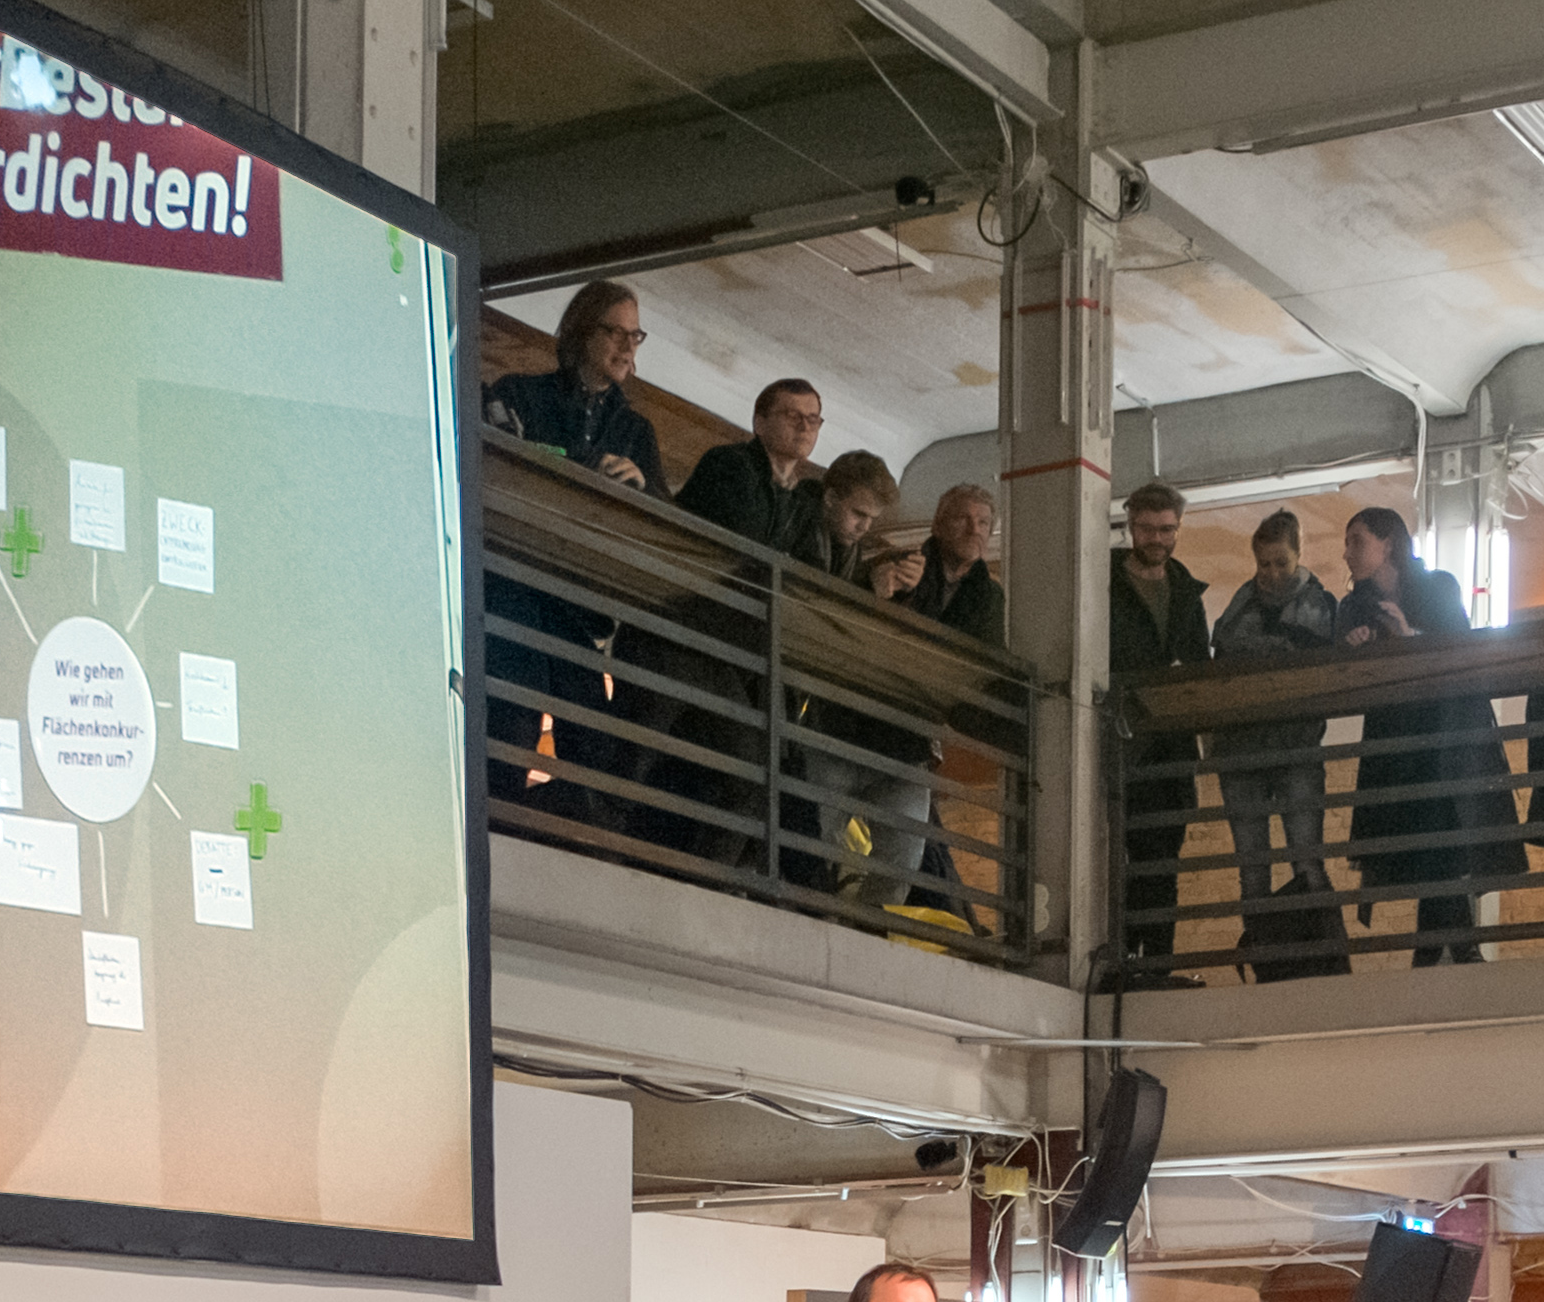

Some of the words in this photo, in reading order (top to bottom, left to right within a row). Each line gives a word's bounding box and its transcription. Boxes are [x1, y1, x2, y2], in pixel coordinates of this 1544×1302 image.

[54, 659, 81, 678] Wie
[83, 662, 124, 684] gehen
[69, 687, 90, 707] wir
[92, 689, 114, 709] mit
[57, 750, 103, 767] renzen
[106, 749, 134, 769] um?
